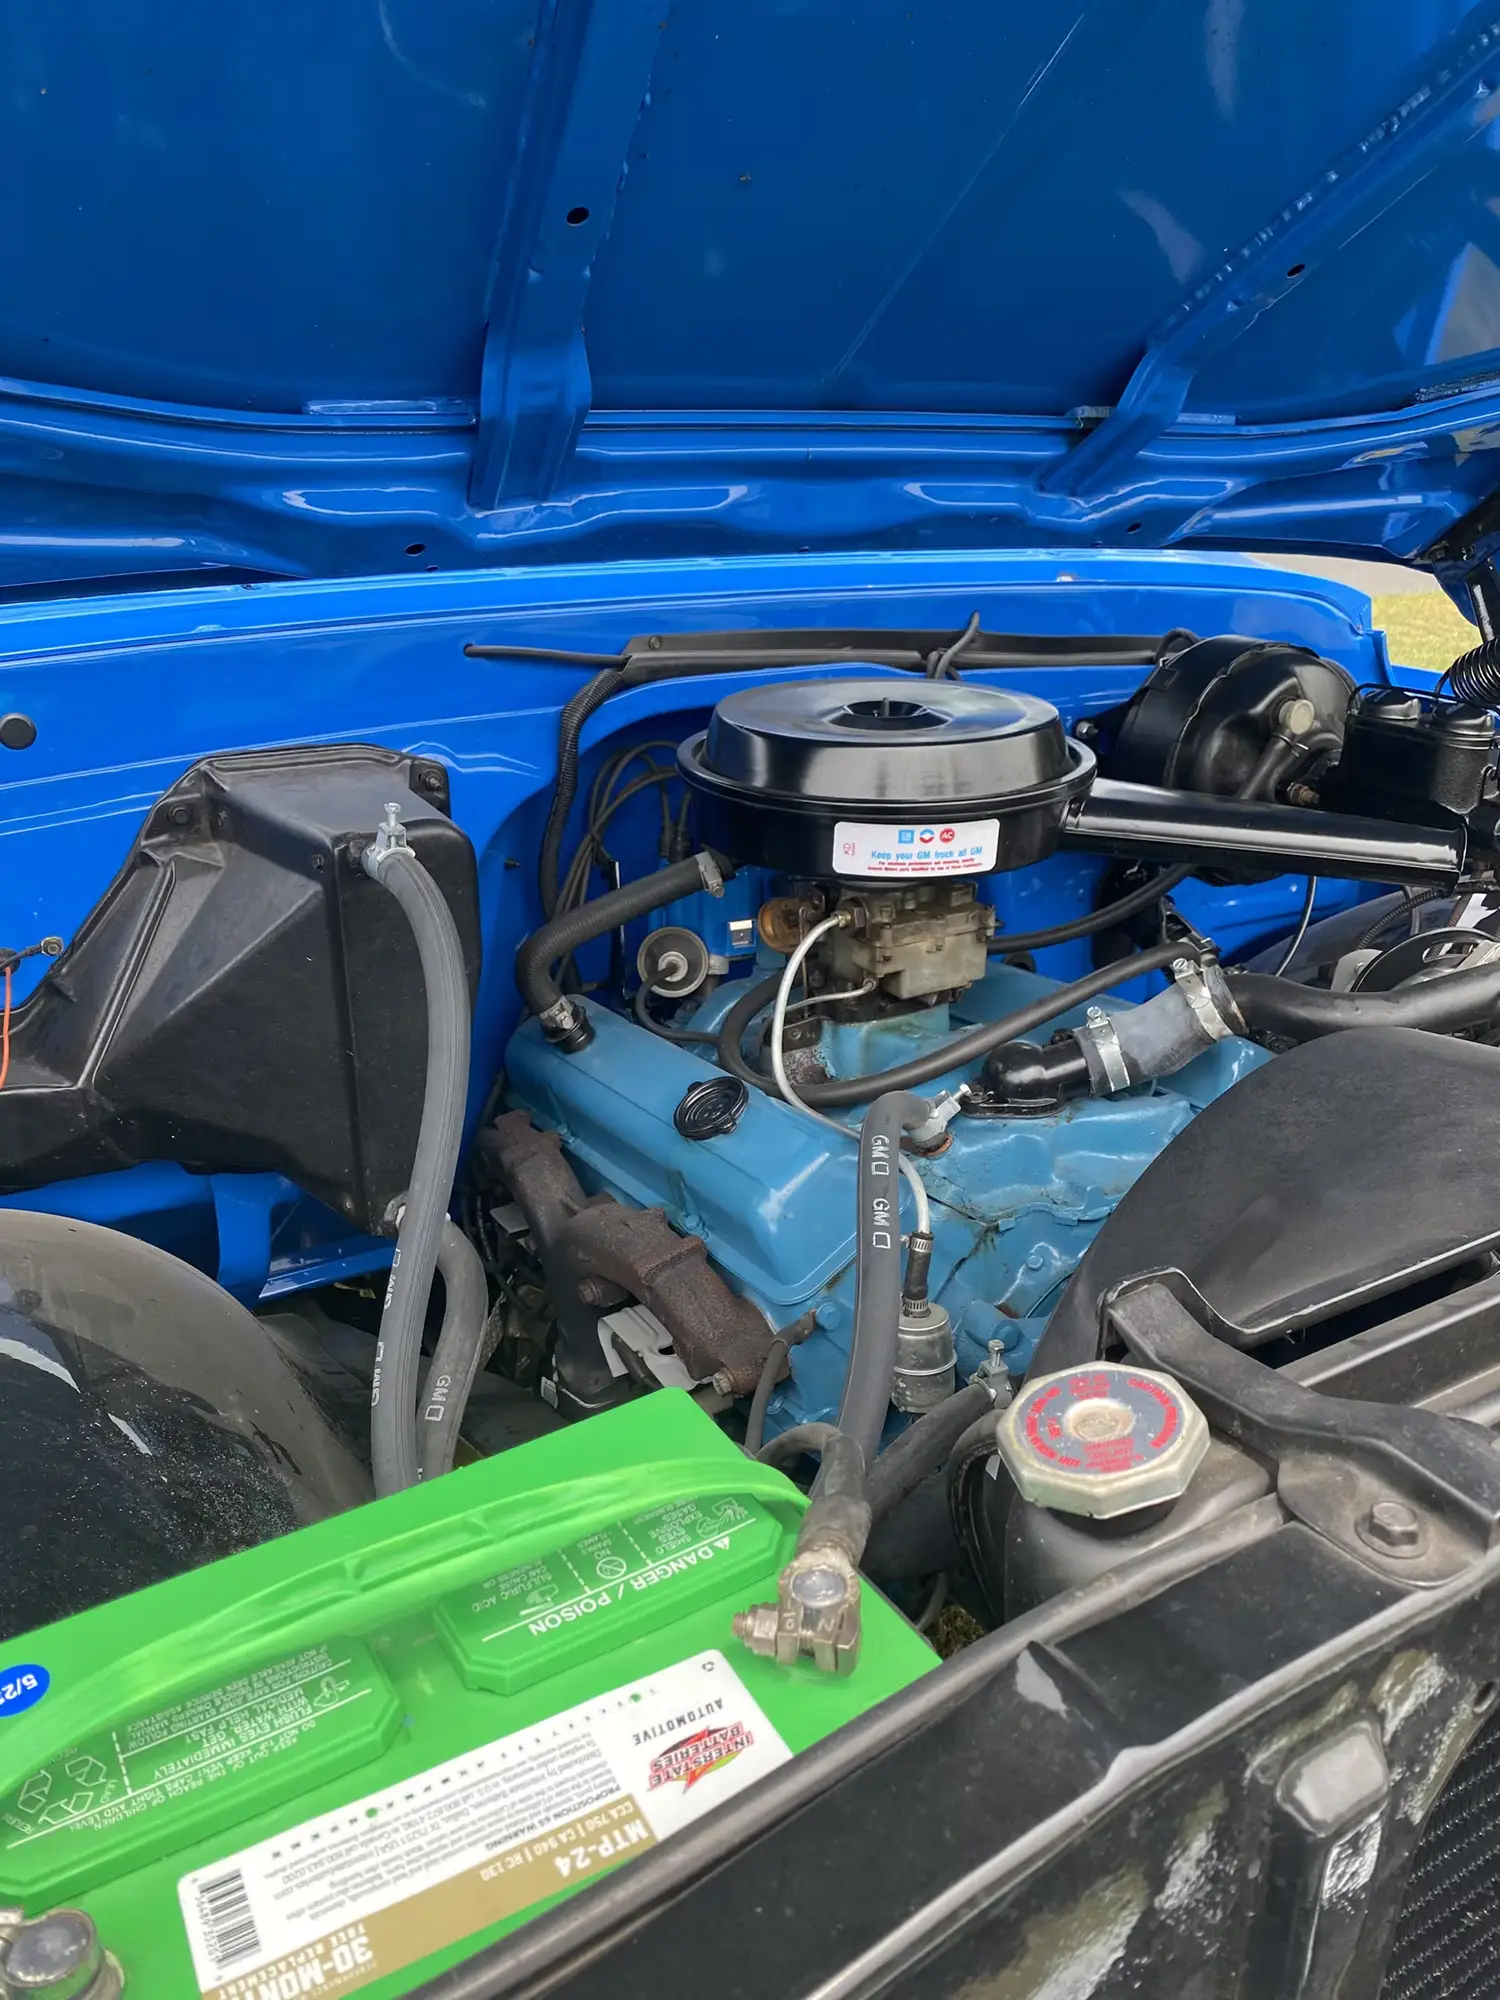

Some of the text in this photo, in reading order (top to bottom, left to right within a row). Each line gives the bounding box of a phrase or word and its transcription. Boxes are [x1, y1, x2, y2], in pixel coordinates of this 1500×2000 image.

[941, 831, 953, 840] AC
[871, 846, 983, 861] Keep your GM truck all GM
[871, 1134, 890, 1159] GM
[873, 1197, 890, 1227] GM
[431, 1374, 452, 1402] GM
[471, 1572, 551, 1611] SULFURIC ACID
[528, 1546, 713, 1635] DANGER / POISON
[183, 1686, 302, 1743] MEDICAL HELP FAST
[275, 1696, 307, 1715] WITH
[632, 1697, 723, 1745] AUTOMOTIVE
[127, 1729, 160, 1750] FOLLOW
[152, 1704, 310, 1779] FLUSH EYES IMMEDIATELY
[199, 1730, 225, 1747] GET
[652, 1726, 739, 1770] BATTERIES
[248, 1748, 268, 1762] OUT
[651, 1735, 750, 1785] INTERSTATE
[195, 1760, 221, 1776] VENT
[206, 1768, 225, 1781] THE
[165, 1773, 192, 1790] CAPS
[168, 1778, 201, 1797] REACH
[129, 1787, 161, 1805] TIGHT
[552, 1782, 619, 1821] PROPOSITION
[94, 1801, 145, 1830] CHILDREN
[103, 1802, 126, 1816] AND
[609, 1800, 634, 1820] CCA
[584, 1810, 610, 1832] 750
[485, 1823, 535, 1850] WARNING
[557, 1827, 576, 1844] CA
[553, 1817, 647, 1878] MTP-24
[478, 1861, 504, 1881] 130
[219, 1923, 366, 1999] FREE REPLACEMENT
[230, 1935, 374, 2000] 30-MON
